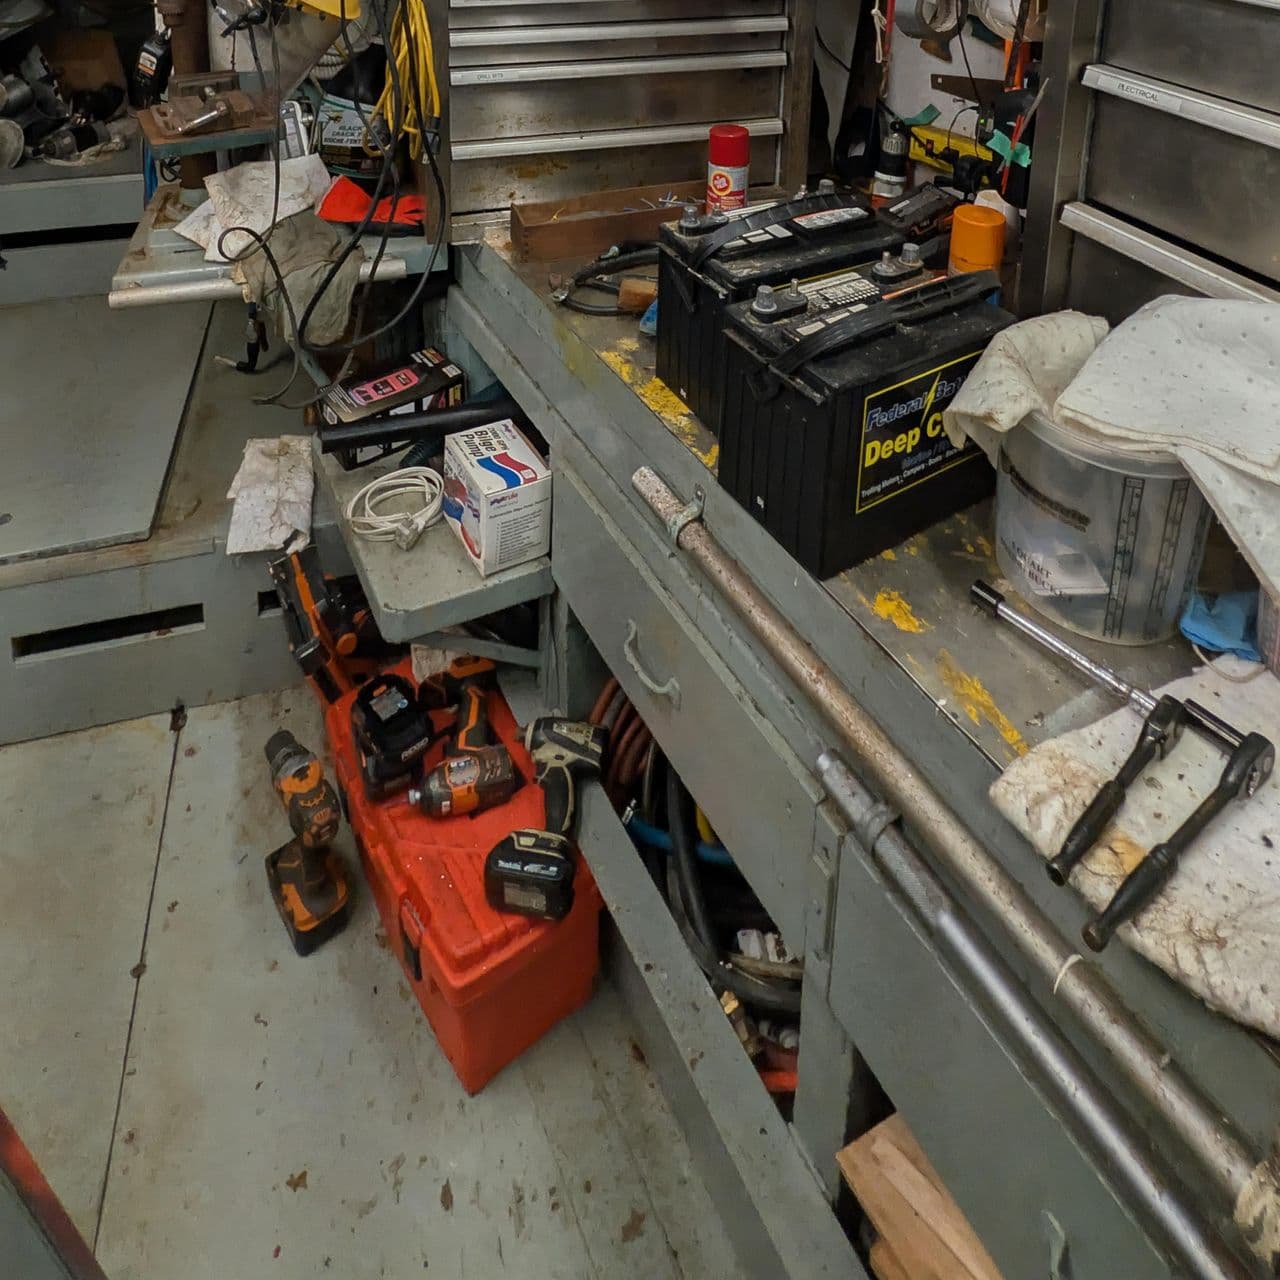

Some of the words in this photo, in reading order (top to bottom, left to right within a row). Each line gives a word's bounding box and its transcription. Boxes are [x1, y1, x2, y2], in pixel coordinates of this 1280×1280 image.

[864, 391, 928, 433] Federal
[460, 433, 484, 458] Pump
[473, 430, 497, 452] Bilge
[864, 426, 921, 469] Deep
[926, 412, 948, 438] C
